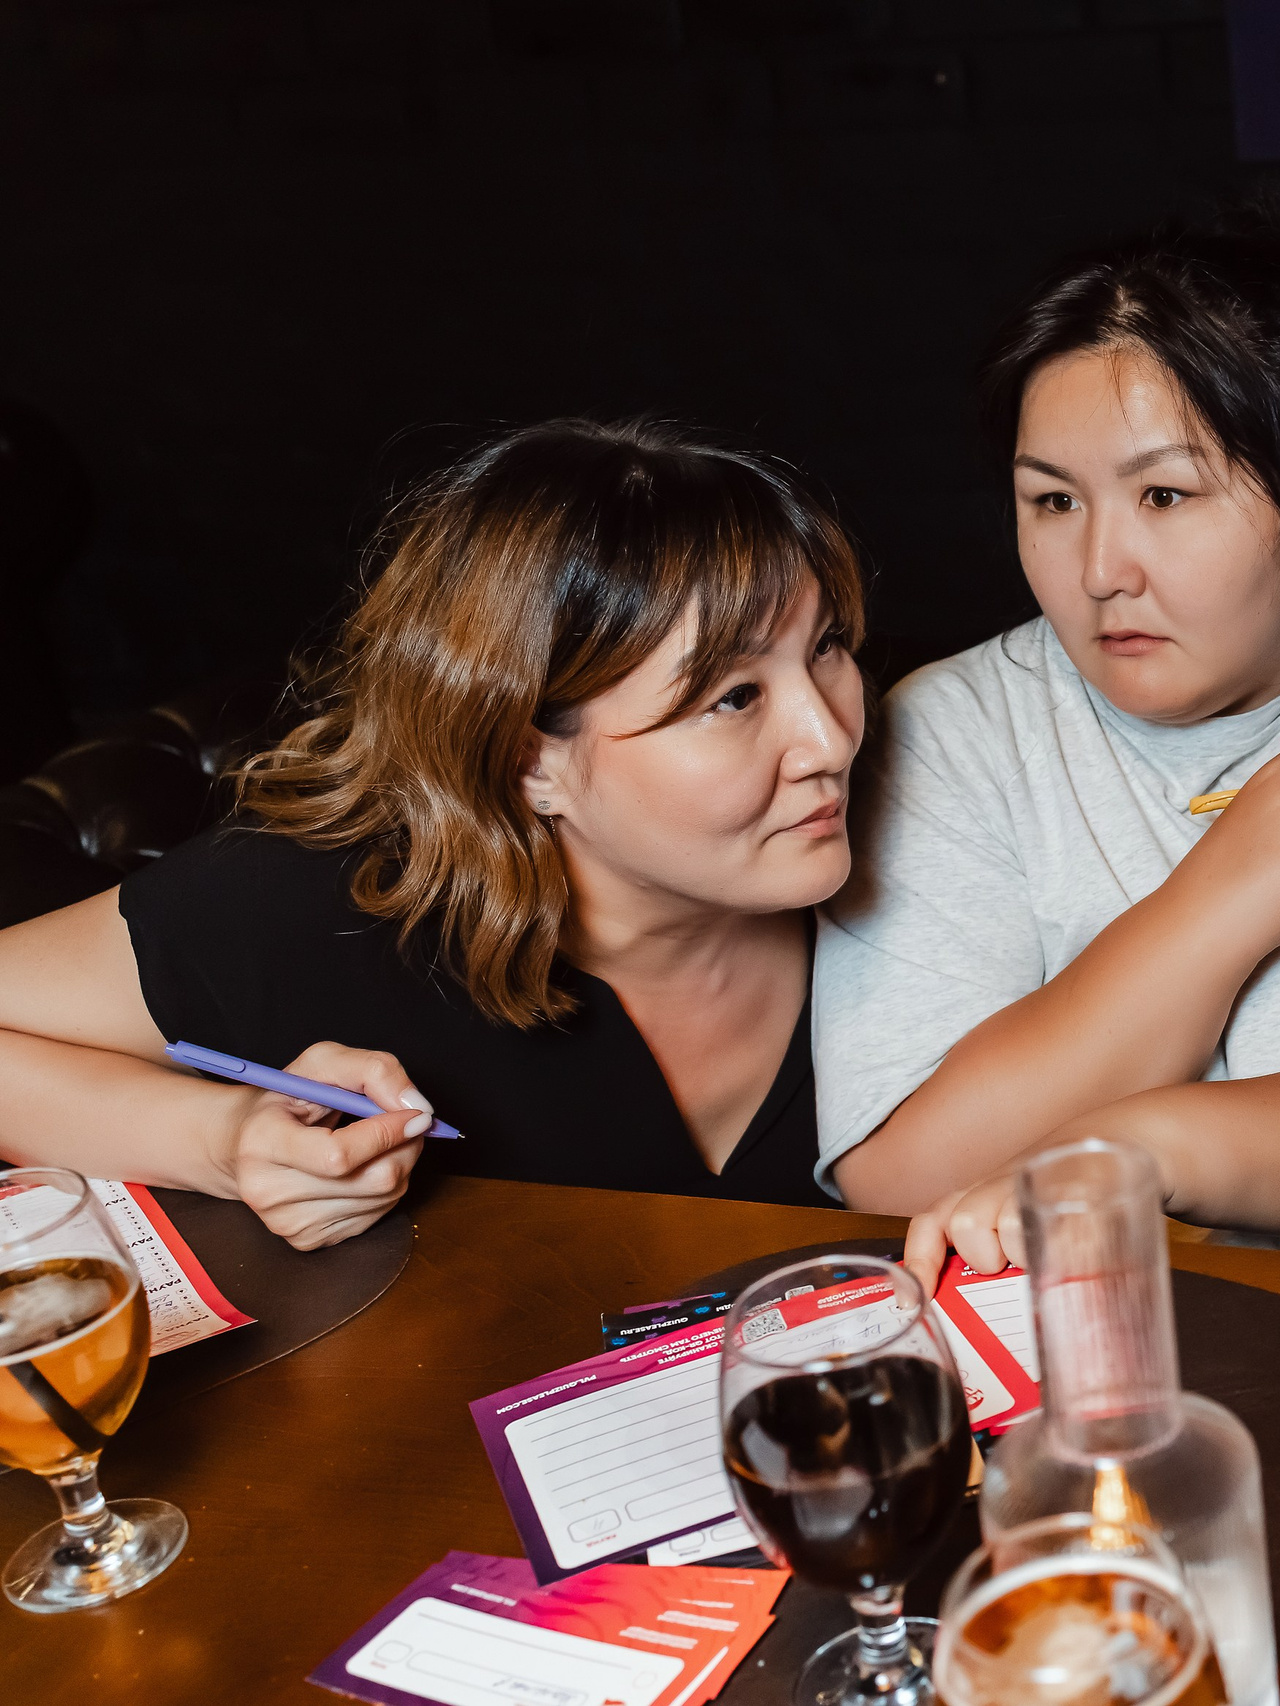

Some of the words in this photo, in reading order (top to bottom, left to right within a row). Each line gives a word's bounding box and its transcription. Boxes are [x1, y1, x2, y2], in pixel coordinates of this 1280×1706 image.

[127, 1236, 154, 1249] РАУ
[146, 1278, 182, 1295] РАУН
[620, 1317, 688, 1335] QUIZPLEASE.RU
[670, 1338, 691, 1348] ТАМ
[620, 1344, 669, 1363] СМОТРЕТЬ
[657, 1342, 719, 1365] СКАНИРУЙТЕ
[496, 1375, 597, 1414] PVL.QUIZPLEASE.COM
